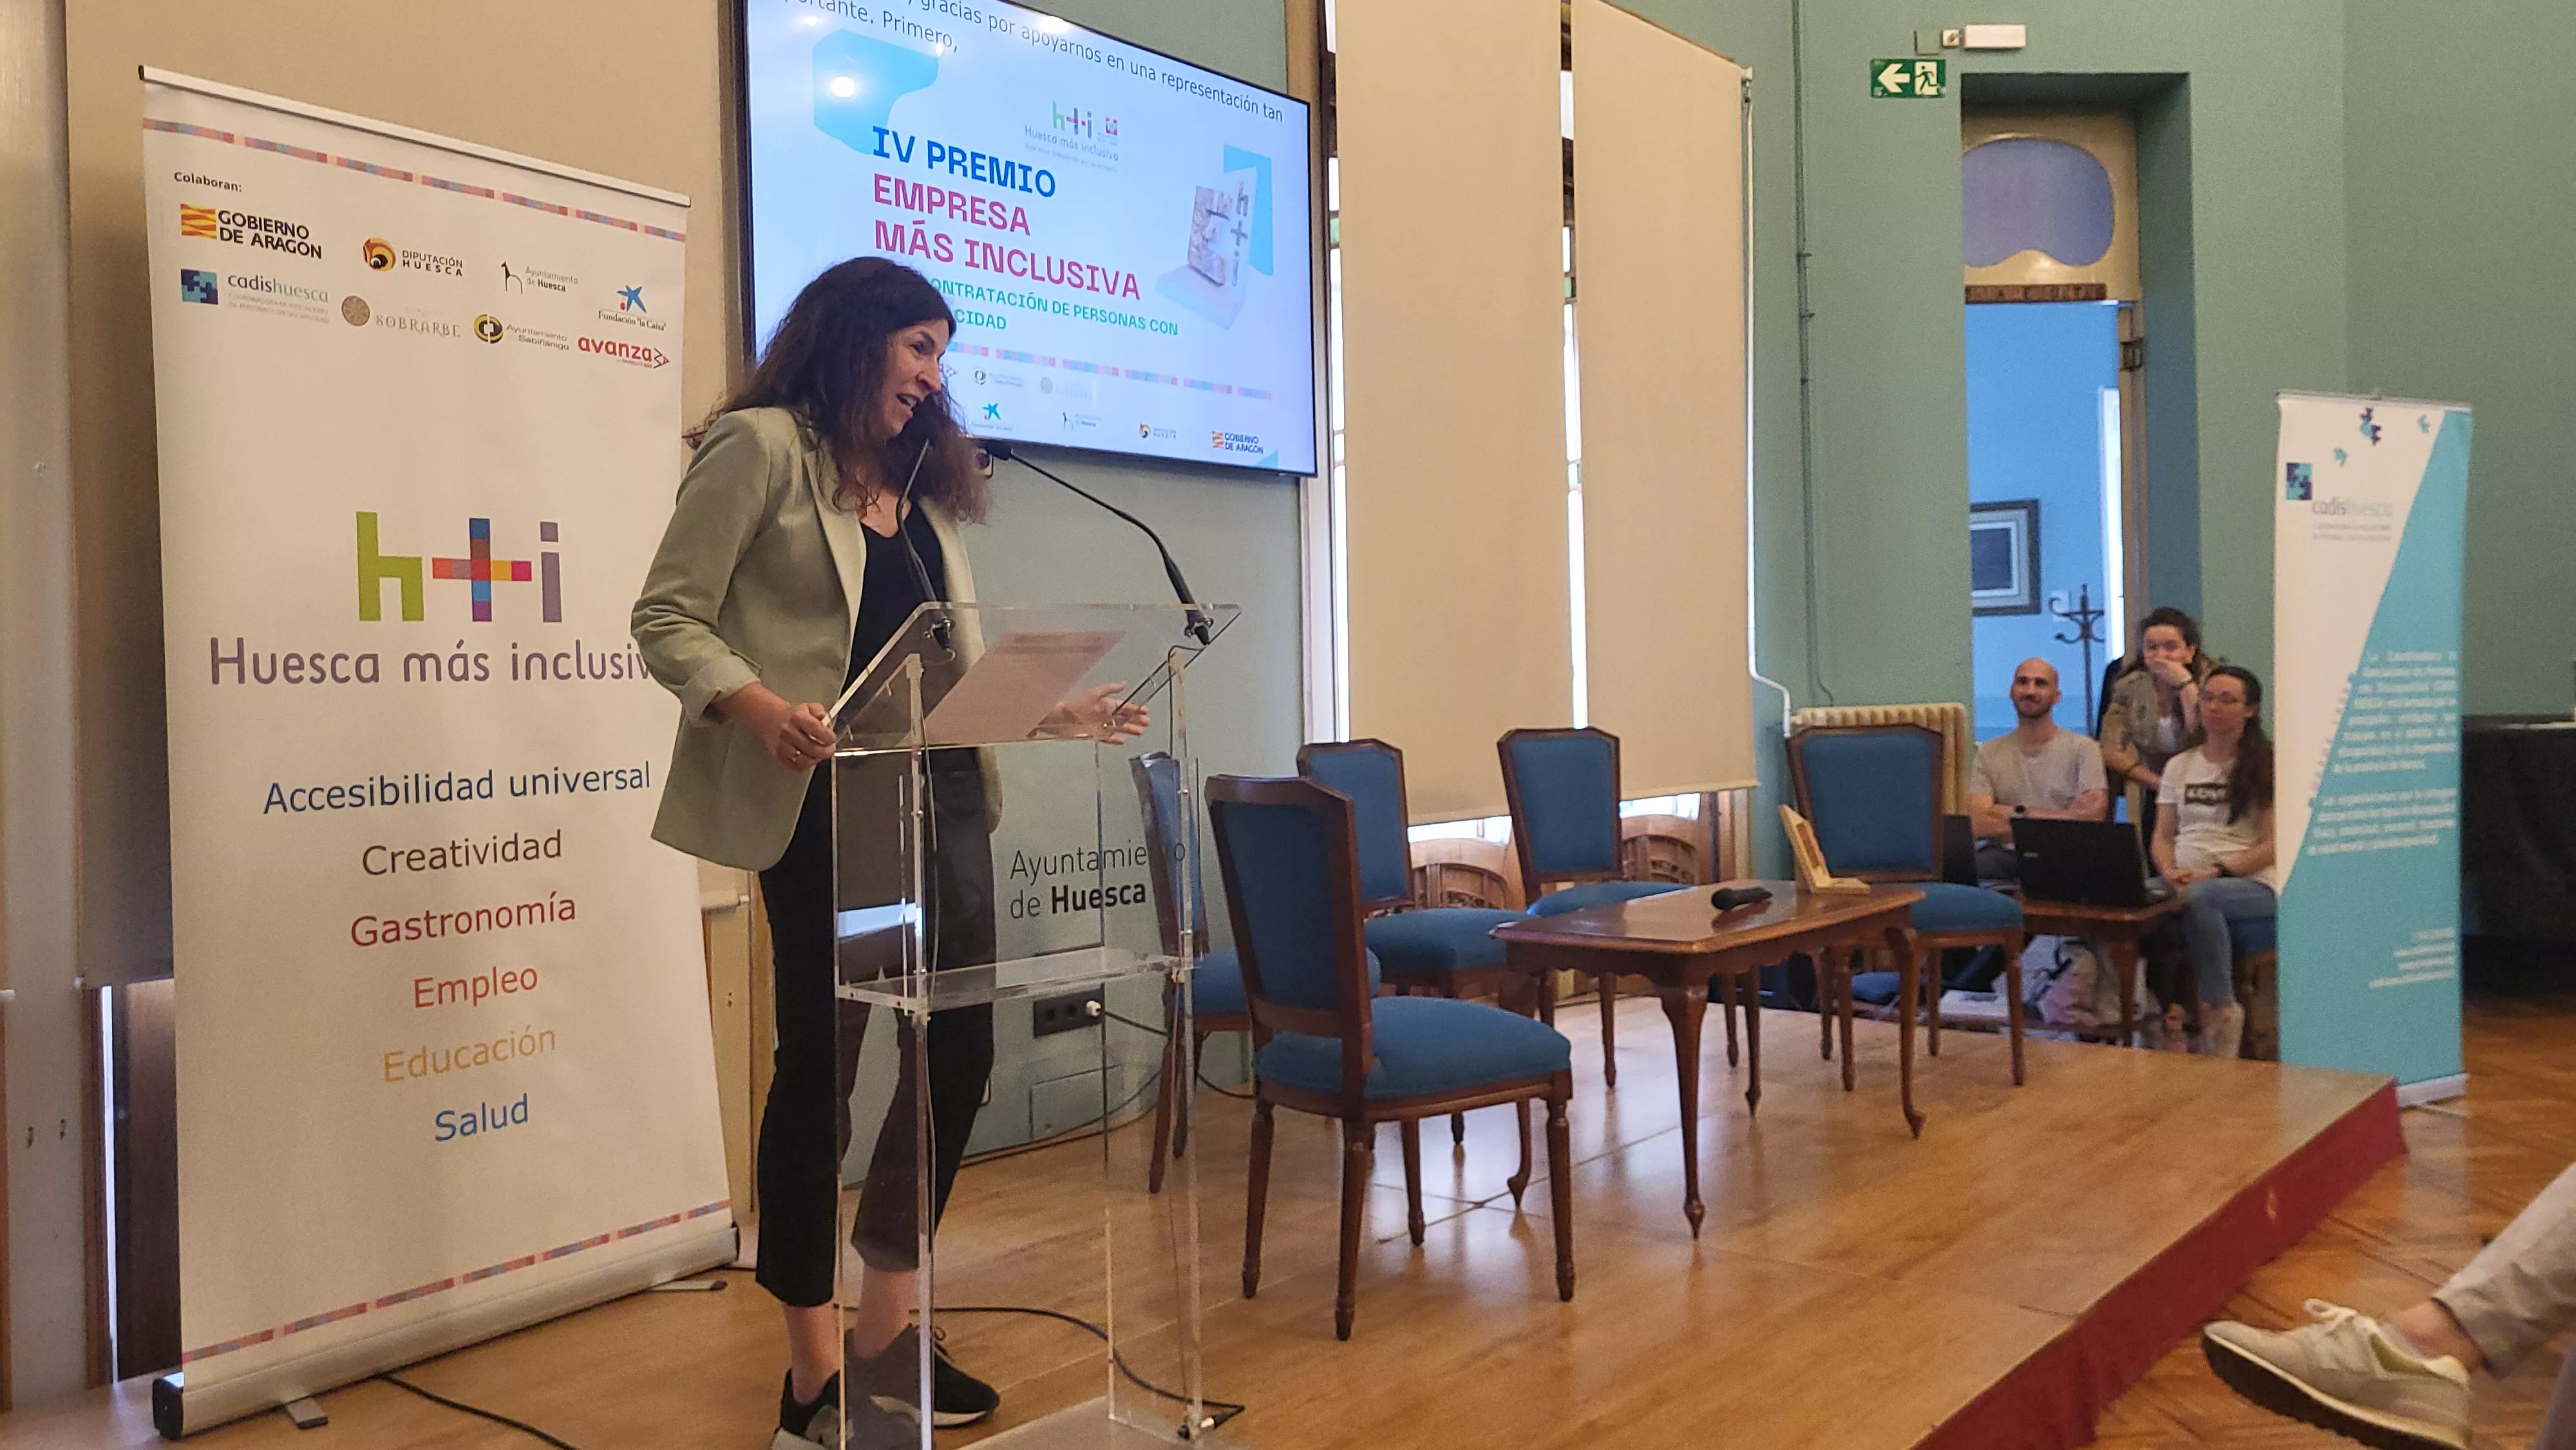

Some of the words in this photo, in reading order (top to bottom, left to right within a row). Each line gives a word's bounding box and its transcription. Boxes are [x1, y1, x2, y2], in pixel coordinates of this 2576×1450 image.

[883, 10, 958, 53] Primero,
[989, 13, 1016, 34] por
[1022, 24, 1101, 64] apoyarnos
[1107, 54, 1124, 71] en
[1130, 62, 1156, 81] una
[1162, 71, 1258, 115] representación
[1263, 103, 1283, 122] tan
[1025, 125, 1057, 144] Huesca
[1061, 138, 1078, 150] más
[1081, 144, 1119, 161] inclusiva
[873, 126, 916, 164] IV
[927, 140, 1056, 198] PREMIO
[175, 172, 242, 193] Colaboran:
[874, 173, 1030, 236] EMPRESA
[218, 210, 310, 240] GOBIERNO
[220, 227, 244, 244] DE
[251, 233, 323, 259] ARAGON
[402, 250, 463, 268] DIPUTACIÓN
[403, 259, 462, 277] HUESCA
[526, 266, 578, 284] Ayuntamiento
[875, 219, 954, 263] MÁS
[965, 238, 1141, 301] INCLUSIVA
[228, 274, 328, 303] cadishuesca
[527, 277, 535, 285] de
[538, 279, 566, 292] Huesca
[598, 310, 636, 325] Fundación
[931, 278, 1048, 312] ONTRATACIÓN
[1052, 300, 1070, 315] DE
[1074, 305, 1146, 330] PERSONAS
[1150, 319, 1178, 335] CON
[954, 309, 1007, 330] CIDAD
[506, 324, 568, 341] Ayuntamiento
[578, 336, 652, 362] avanza
[1225, 432, 1259, 444] GOBIERNO
[1225, 442, 1233, 451] DE
[210, 637, 380, 685] Huesca
[404, 639, 491, 683] más
[511, 640, 649, 681] inclusiv
[263, 769, 493, 814] Accesibilidad
[509, 761, 651, 798] universal
[362, 829, 562, 876] Creatividad
[1010, 840, 1186, 886] Ayuntamieo
[350, 891, 576, 947] Gastronomía
[1010, 890, 1041, 919] de
[1052, 883, 1146, 914] Huesca
[414, 966, 538, 1008] Empleo
[384, 1024, 557, 1084] Educación
[435, 1093, 529, 1142] Salud
